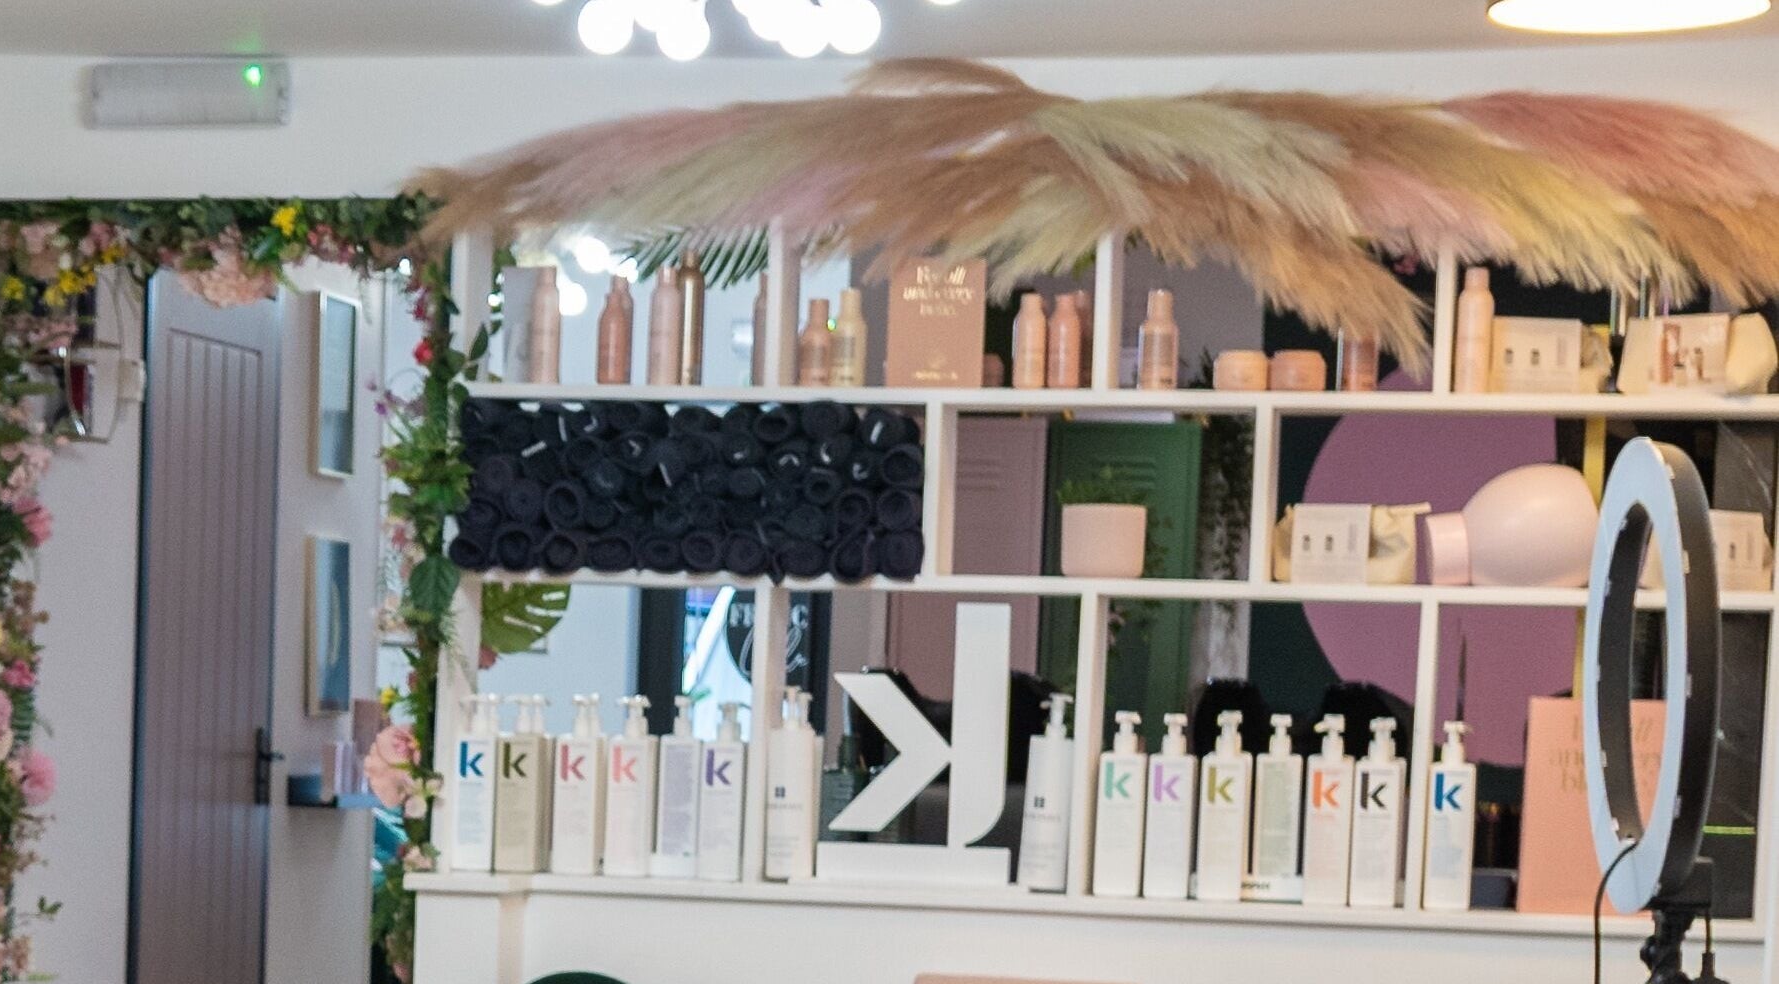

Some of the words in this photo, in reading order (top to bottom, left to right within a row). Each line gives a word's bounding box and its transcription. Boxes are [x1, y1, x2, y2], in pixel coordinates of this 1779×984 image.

[459, 741, 484, 778] k
[503, 742, 527, 779] k
[560, 744, 585, 781] k
[613, 745, 638, 782] k
[705, 749, 732, 786] k
[1104, 762, 1131, 800] k
[1153, 764, 1181, 802] k
[1207, 766, 1234, 804] k
[1312, 770, 1339, 810] k
[1360, 772, 1387, 810] k
[1435, 773, 1462, 811] k
